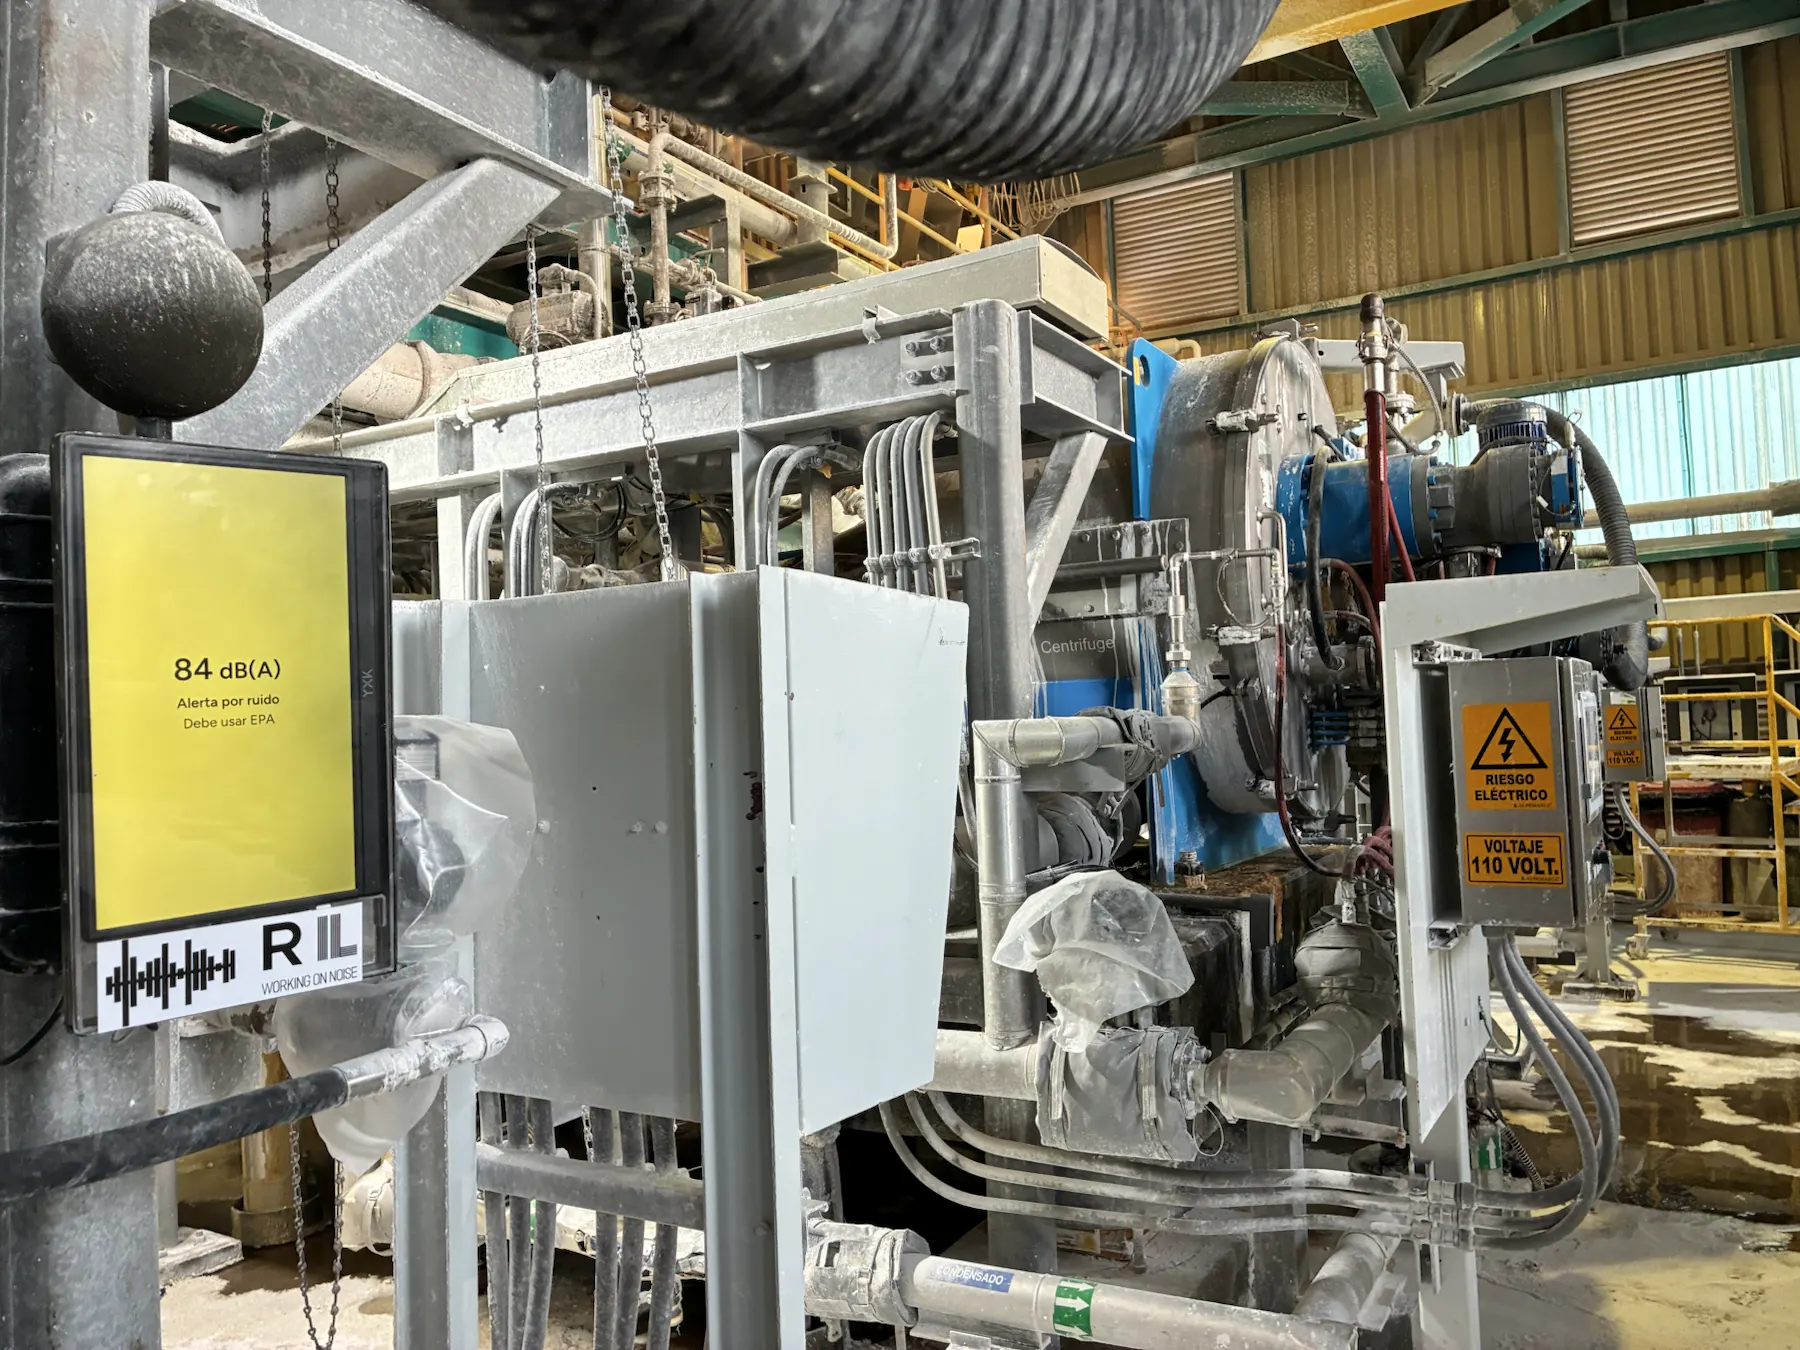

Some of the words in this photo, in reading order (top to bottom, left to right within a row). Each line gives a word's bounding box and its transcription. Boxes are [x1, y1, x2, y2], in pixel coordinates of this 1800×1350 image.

[1040, 637, 1115, 653] Centrifuge
[174, 657, 213, 681] 84
[219, 658, 281, 680] dB(A)
[177, 697, 218, 709] Alerta
[222, 698, 244, 709] por
[247, 694, 280, 705] ruido
[183, 718, 218, 729] Debe
[220, 717, 247, 727] usar
[250, 713, 275, 725] EPA
[1485, 774, 1535, 785] RIESGO
[1475, 787, 1548, 801] ELÉCTRICO
[1484, 839, 1544, 854] VOLTAJE
[1471, 856, 1503, 875] 110
[1507, 856, 1559, 876] VOLT.
[261, 974, 311, 996] WORKING
[312, 971, 328, 986] ON
[329, 965, 358, 983] NOISE
[936, 1265, 1003, 1285] CONDENSADO
